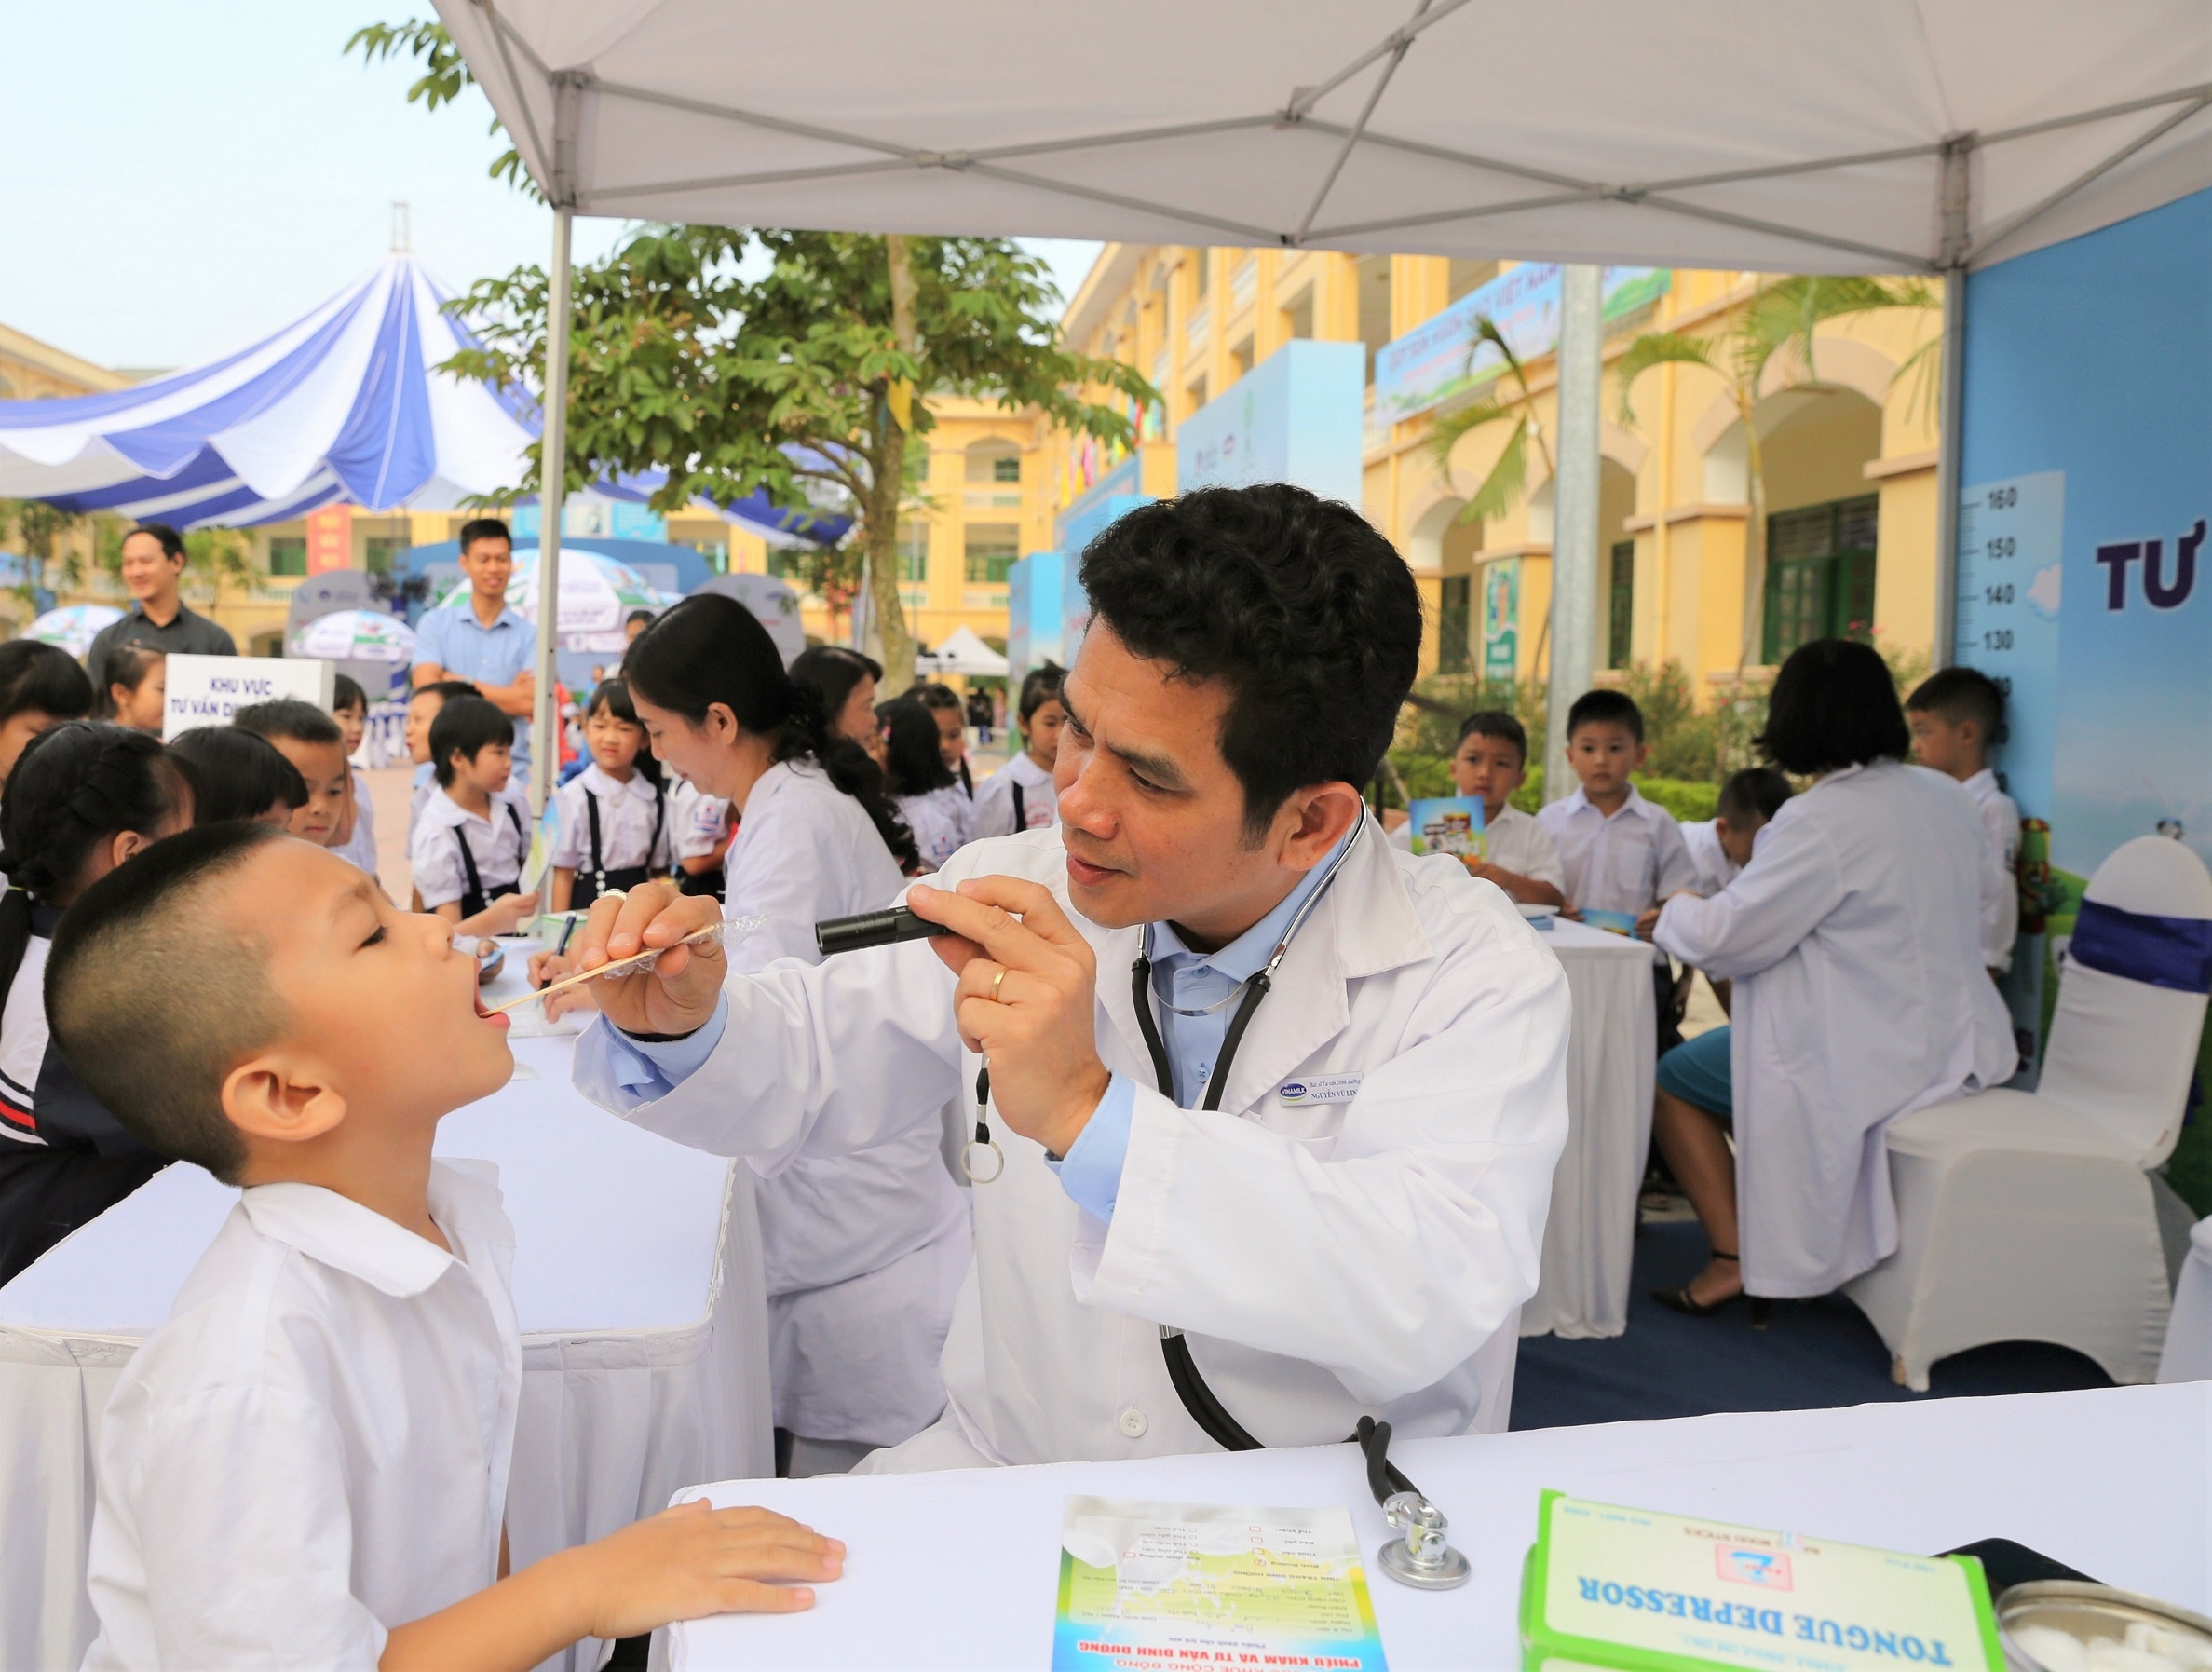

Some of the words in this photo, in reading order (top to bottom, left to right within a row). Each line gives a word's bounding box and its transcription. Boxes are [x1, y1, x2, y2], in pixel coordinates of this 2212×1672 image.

[1988, 485, 2018, 510] 160
[1987, 536, 2017, 559] 150
[2096, 518, 2207, 611] TƯ
[1985, 582, 2015, 605] 140
[1984, 628, 2015, 651] 130
[210, 678, 239, 693] KHU
[1281, 1087, 1306, 1095] VINAMILK
[1577, 1576, 1785, 1638] DEPRESSOR
[1079, 1641, 1132, 1655] DƯỠNG
[1793, 1614, 1953, 1669] TONGUE
[1137, 1647, 1174, 1657] DINH
[1179, 1650, 1210, 1661] VẤN
[1214, 1652, 1234, 1662] TƯ
[1264, 1654, 1310, 1666] KHÁM
[1314, 1657, 1360, 1669] PHIẾU
